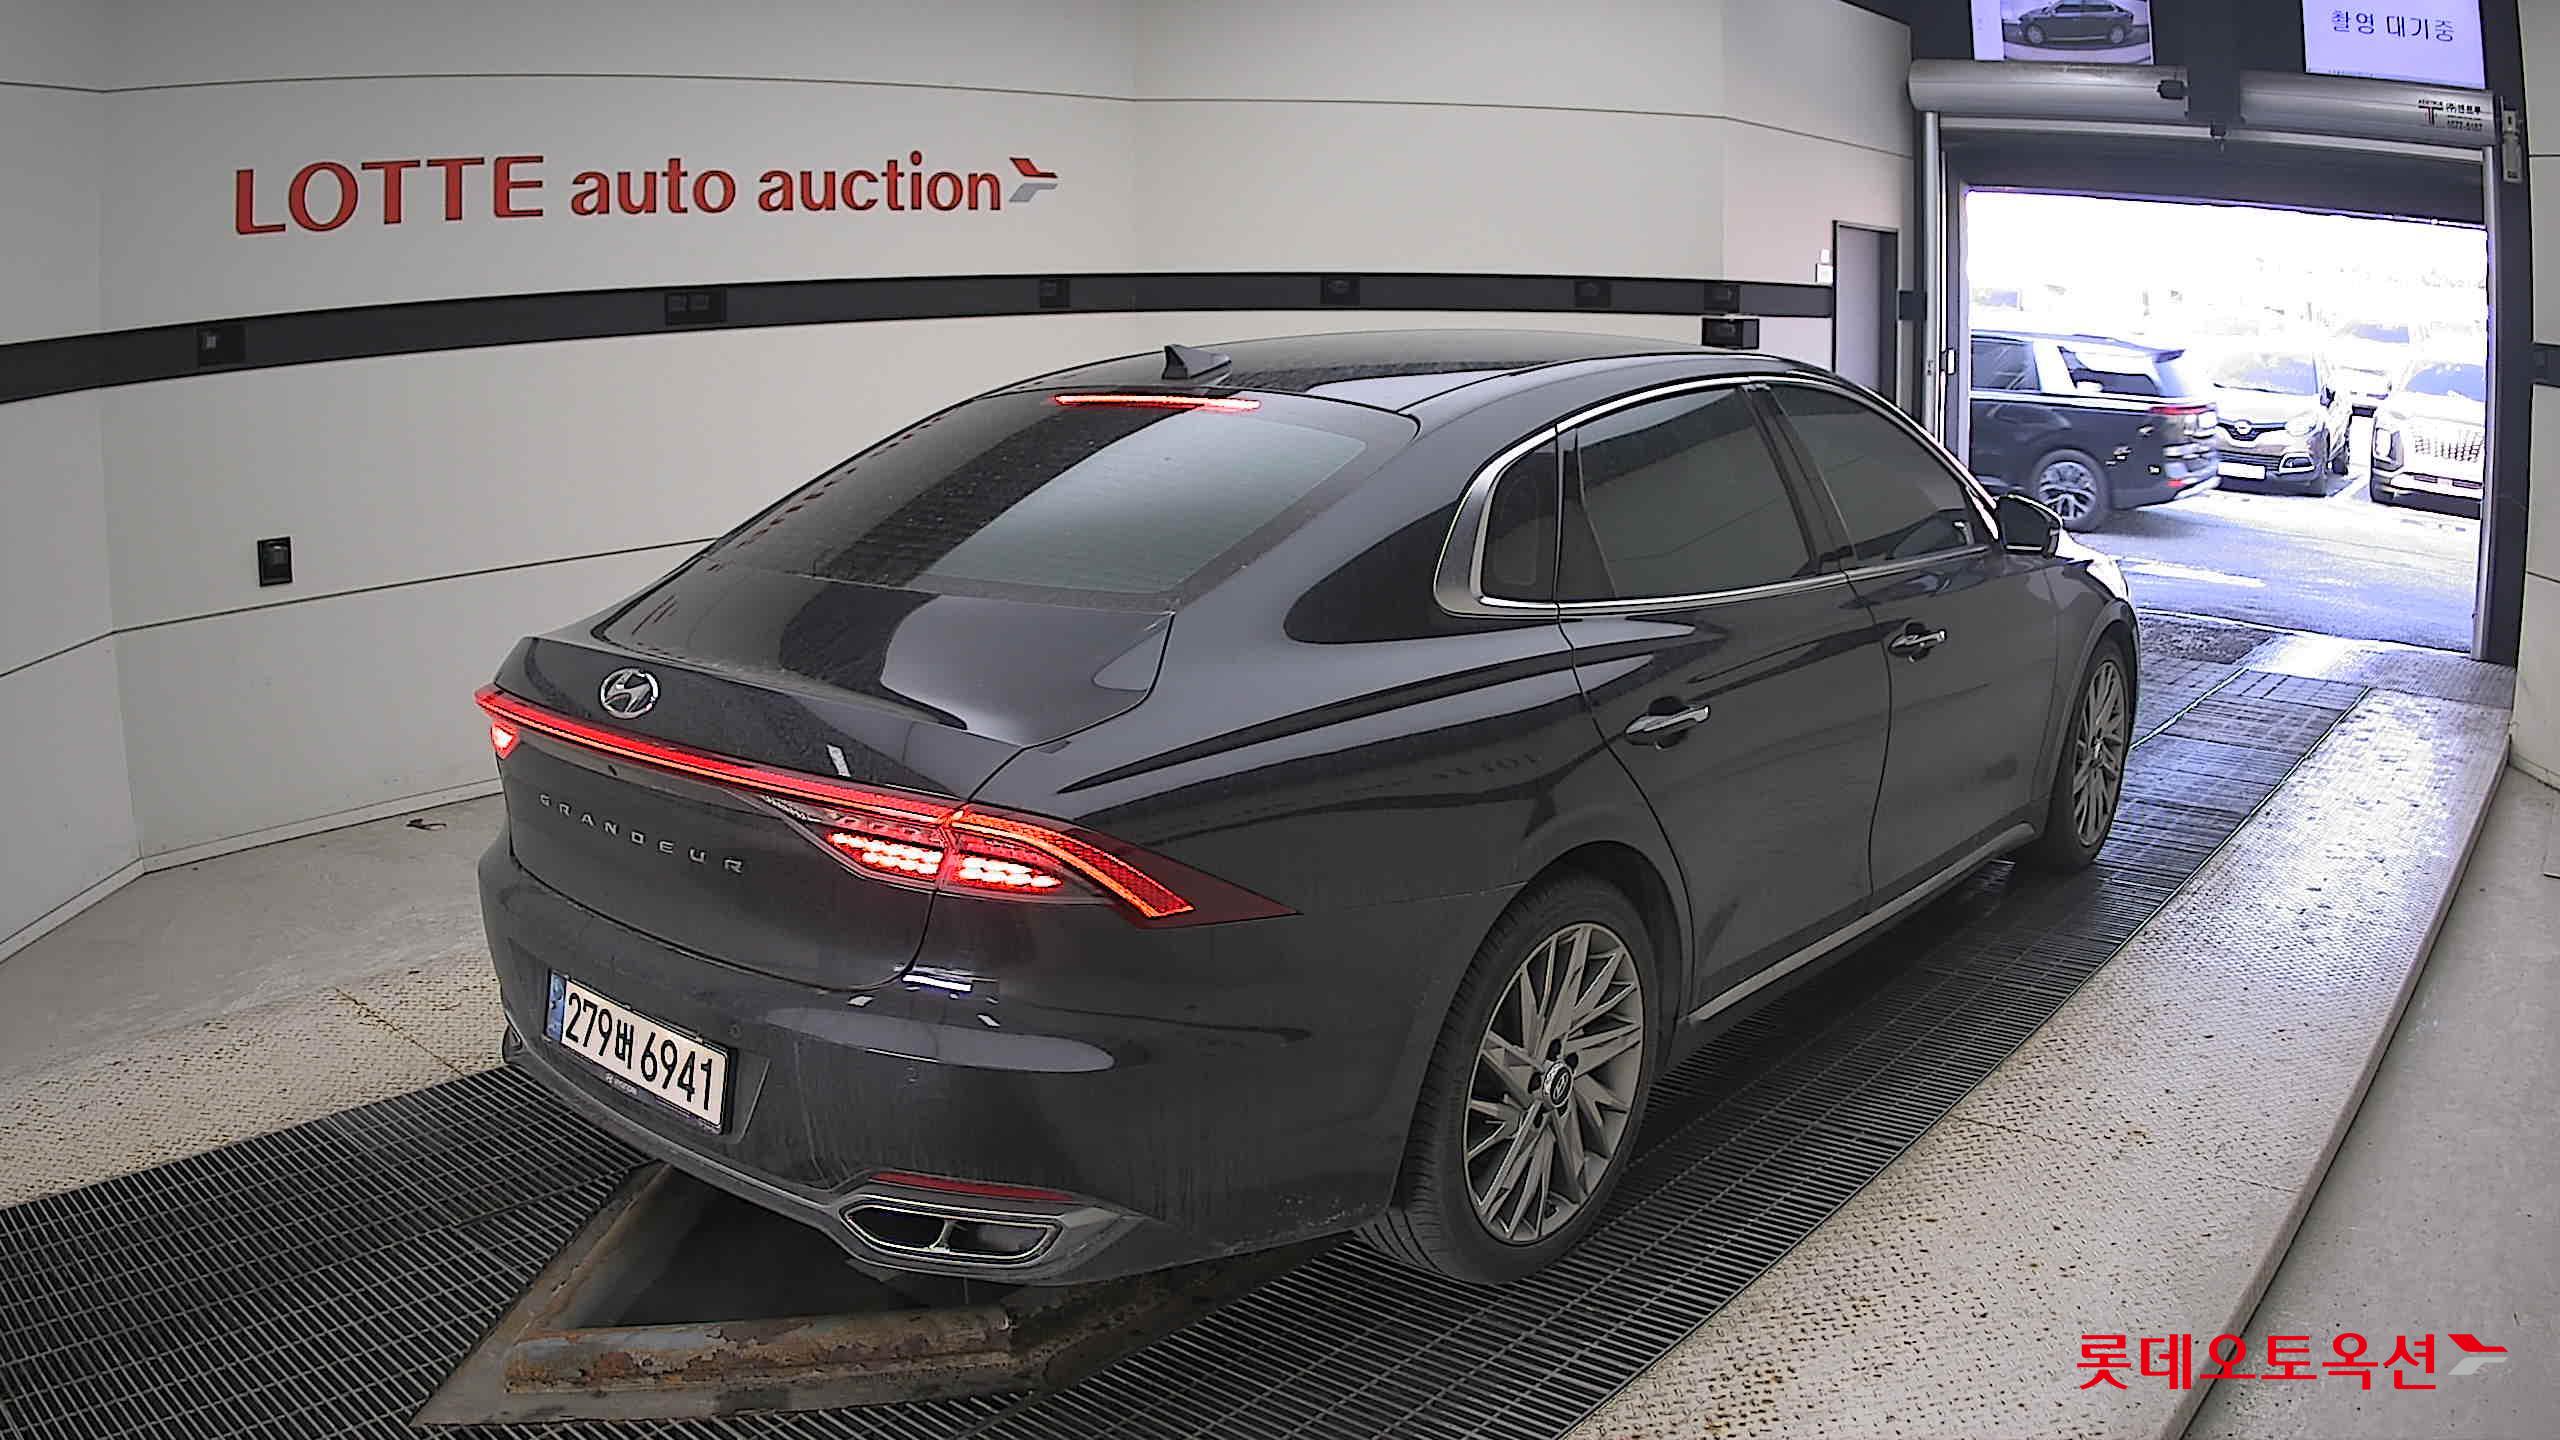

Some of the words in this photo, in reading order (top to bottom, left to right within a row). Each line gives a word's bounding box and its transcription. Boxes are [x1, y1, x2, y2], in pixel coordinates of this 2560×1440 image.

[2331, 9, 2375, 35] 촬영
[235, 155, 544, 235] LOTTE
[569, 158, 736, 216] auto
[758, 150, 1002, 212] auction
[538, 794, 745, 874] GRANDEUR
[641, 1031, 713, 1111] 6941
